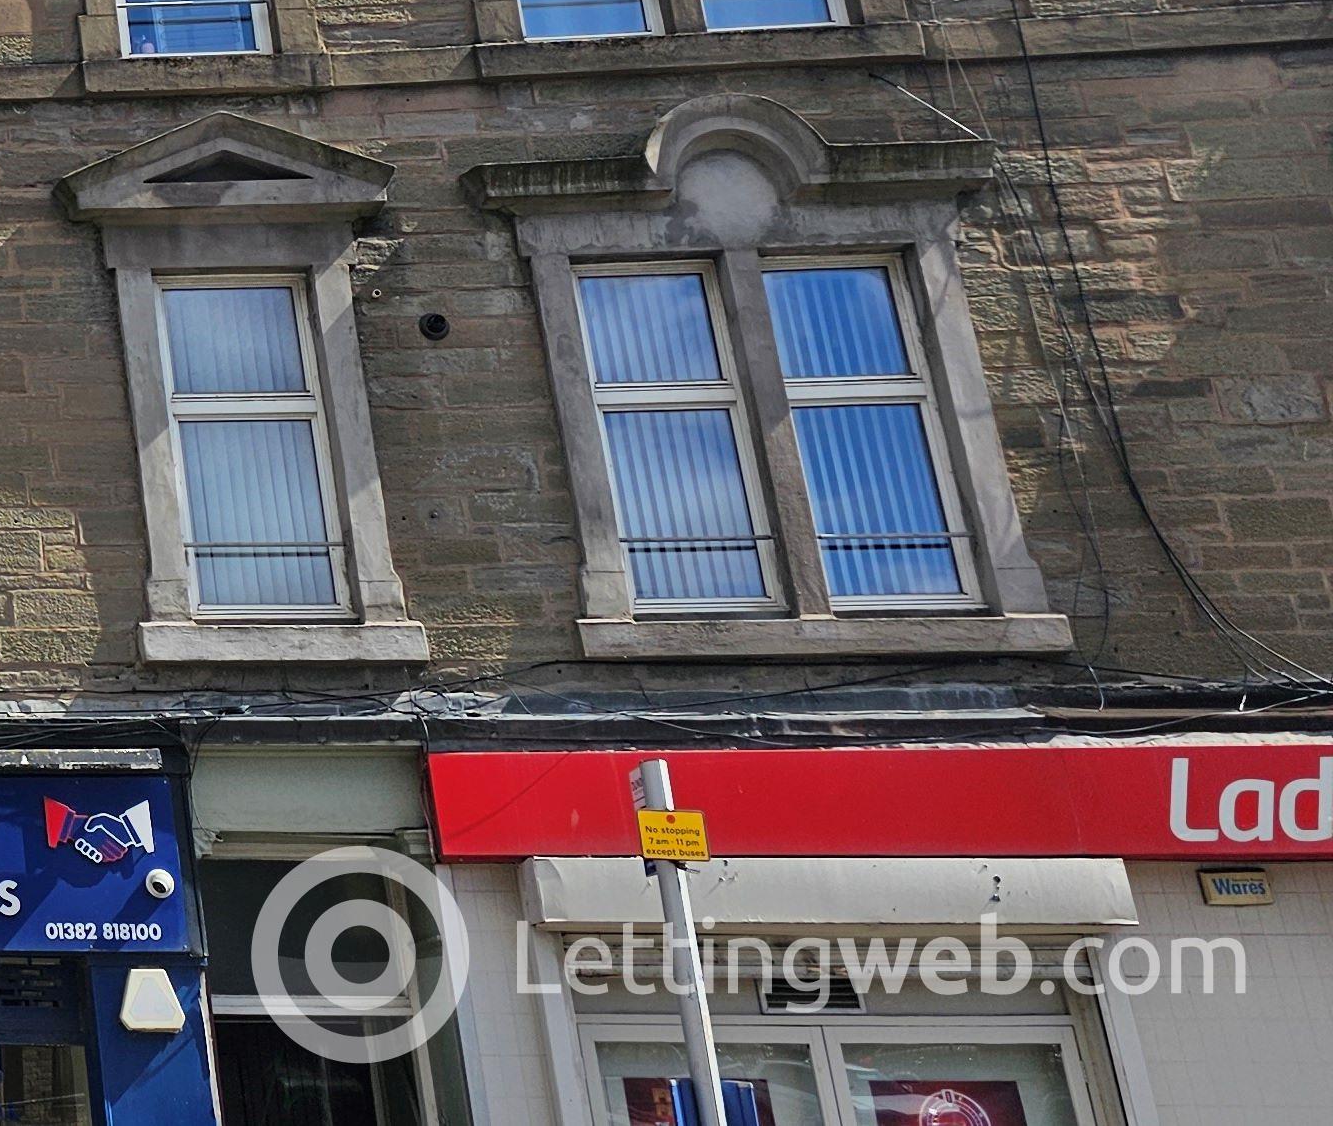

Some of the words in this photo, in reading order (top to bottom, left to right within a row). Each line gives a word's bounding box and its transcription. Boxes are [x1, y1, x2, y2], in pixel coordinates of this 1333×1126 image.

[1169, 756, 1333, 842] Lad
[645, 825, 658, 833] No
[661, 826, 700, 836] stopping
[648, 837, 654, 845] 7
[676, 838, 684, 846] 11
[686, 839, 700, 847] pm
[646, 848, 676, 858] except
[679, 849, 706, 857] buses
[1212, 878, 1267, 895] Wares
[45, 922, 98, 940] 01382
[102, 922, 162, 941] 818100
